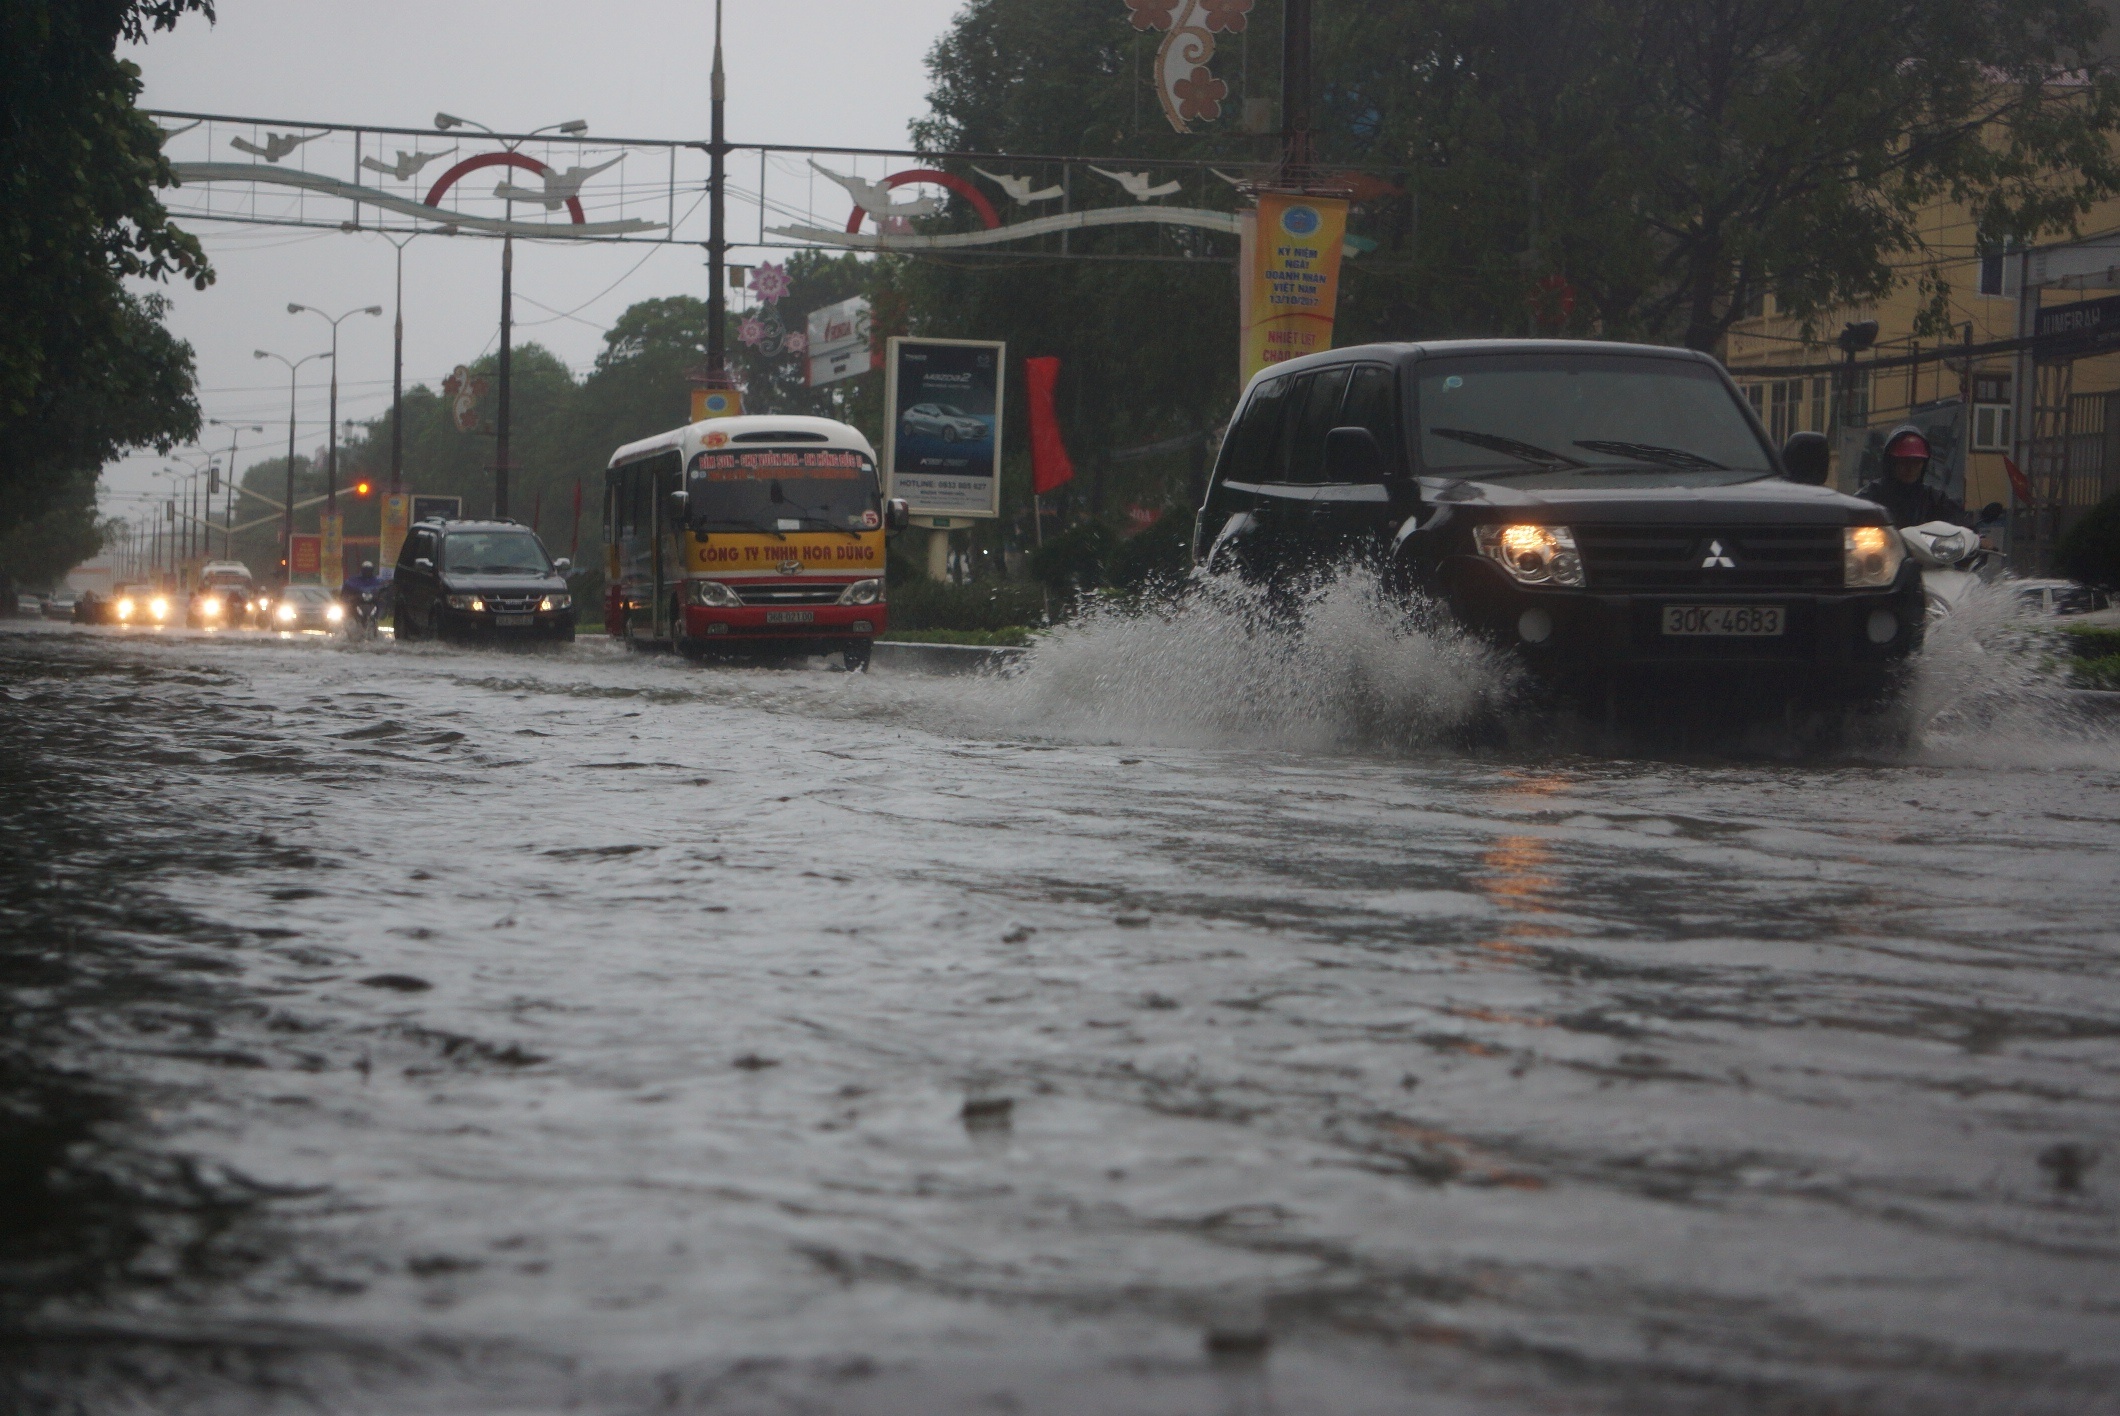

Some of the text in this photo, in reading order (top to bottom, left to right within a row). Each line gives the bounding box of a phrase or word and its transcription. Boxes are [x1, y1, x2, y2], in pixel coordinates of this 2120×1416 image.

[1266, 271, 1299, 280] DOANH
[700, 542, 875, 562] CÔNG TY TNHH HOA DŨNG
